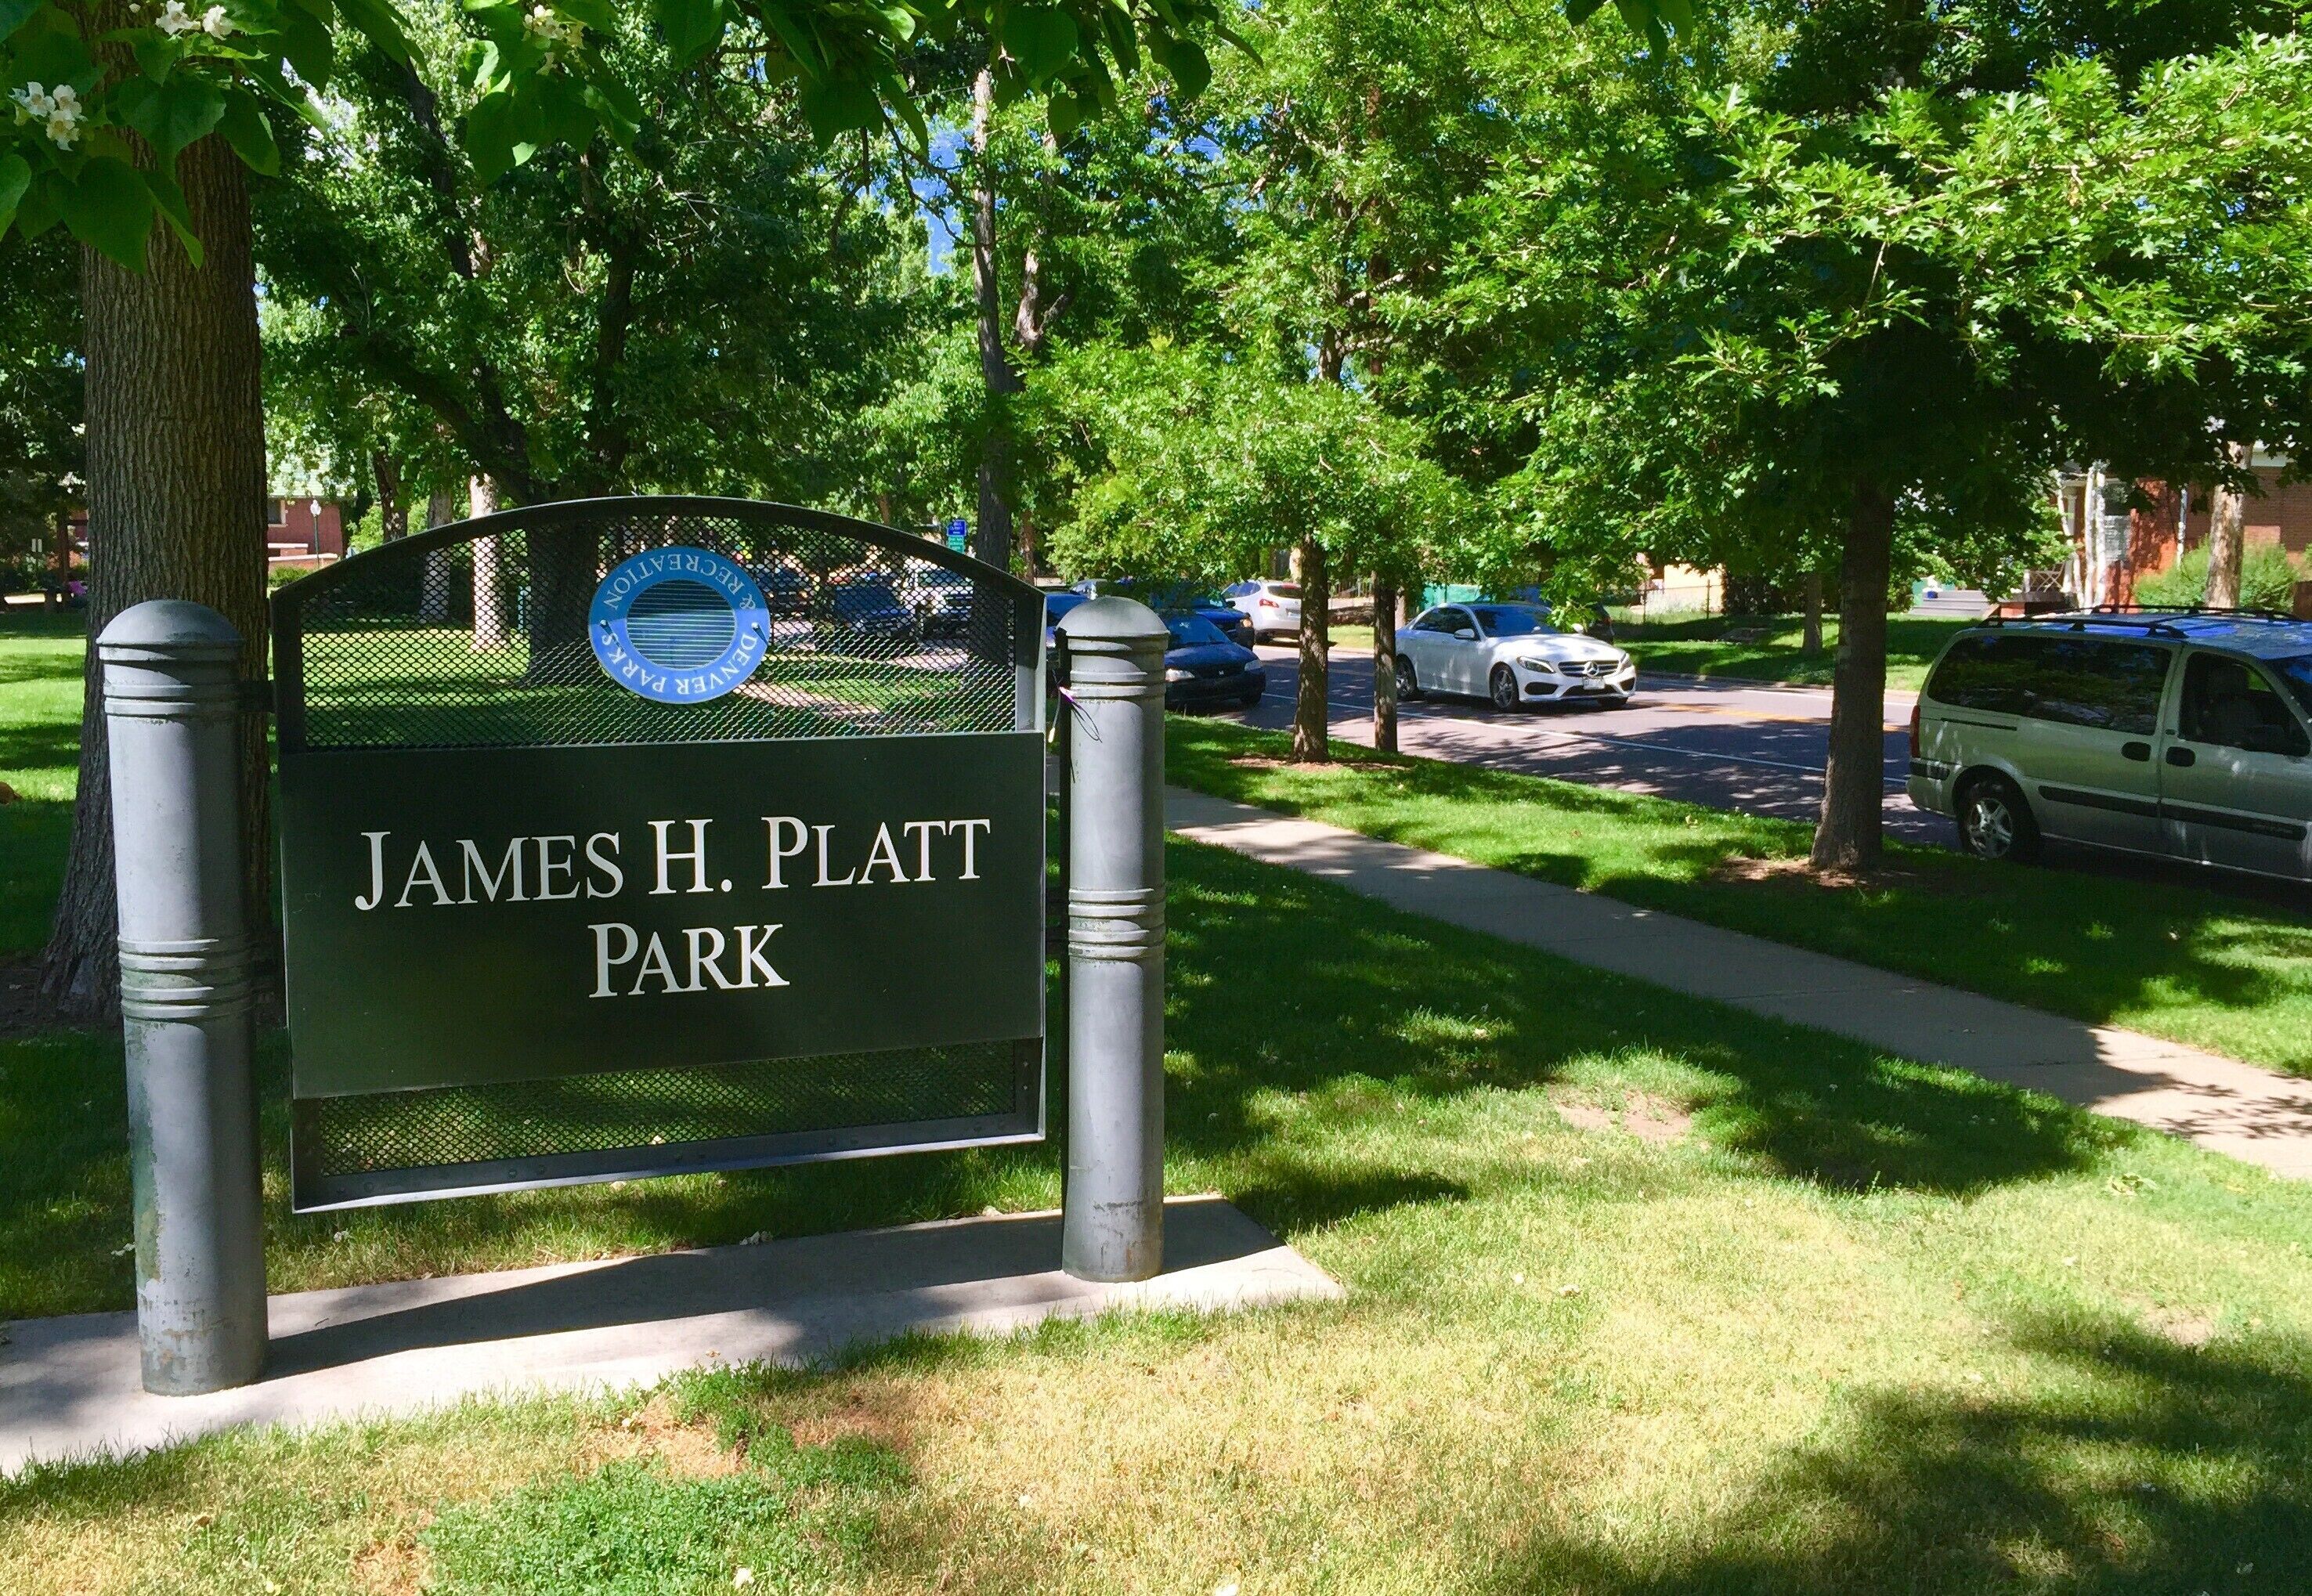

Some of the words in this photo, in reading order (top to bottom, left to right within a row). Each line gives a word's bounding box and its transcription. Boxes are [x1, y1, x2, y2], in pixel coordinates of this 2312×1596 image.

[604, 554, 745, 610] RECREATION
[739, 593, 757, 611] &
[601, 632, 668, 693] PARKS
[674, 633, 758, 695] DENVER
[354, 831, 624, 911] JAMES
[647, 818, 732, 895] H.
[760, 816, 991, 890] PLATT
[588, 923, 789, 998] PARK
